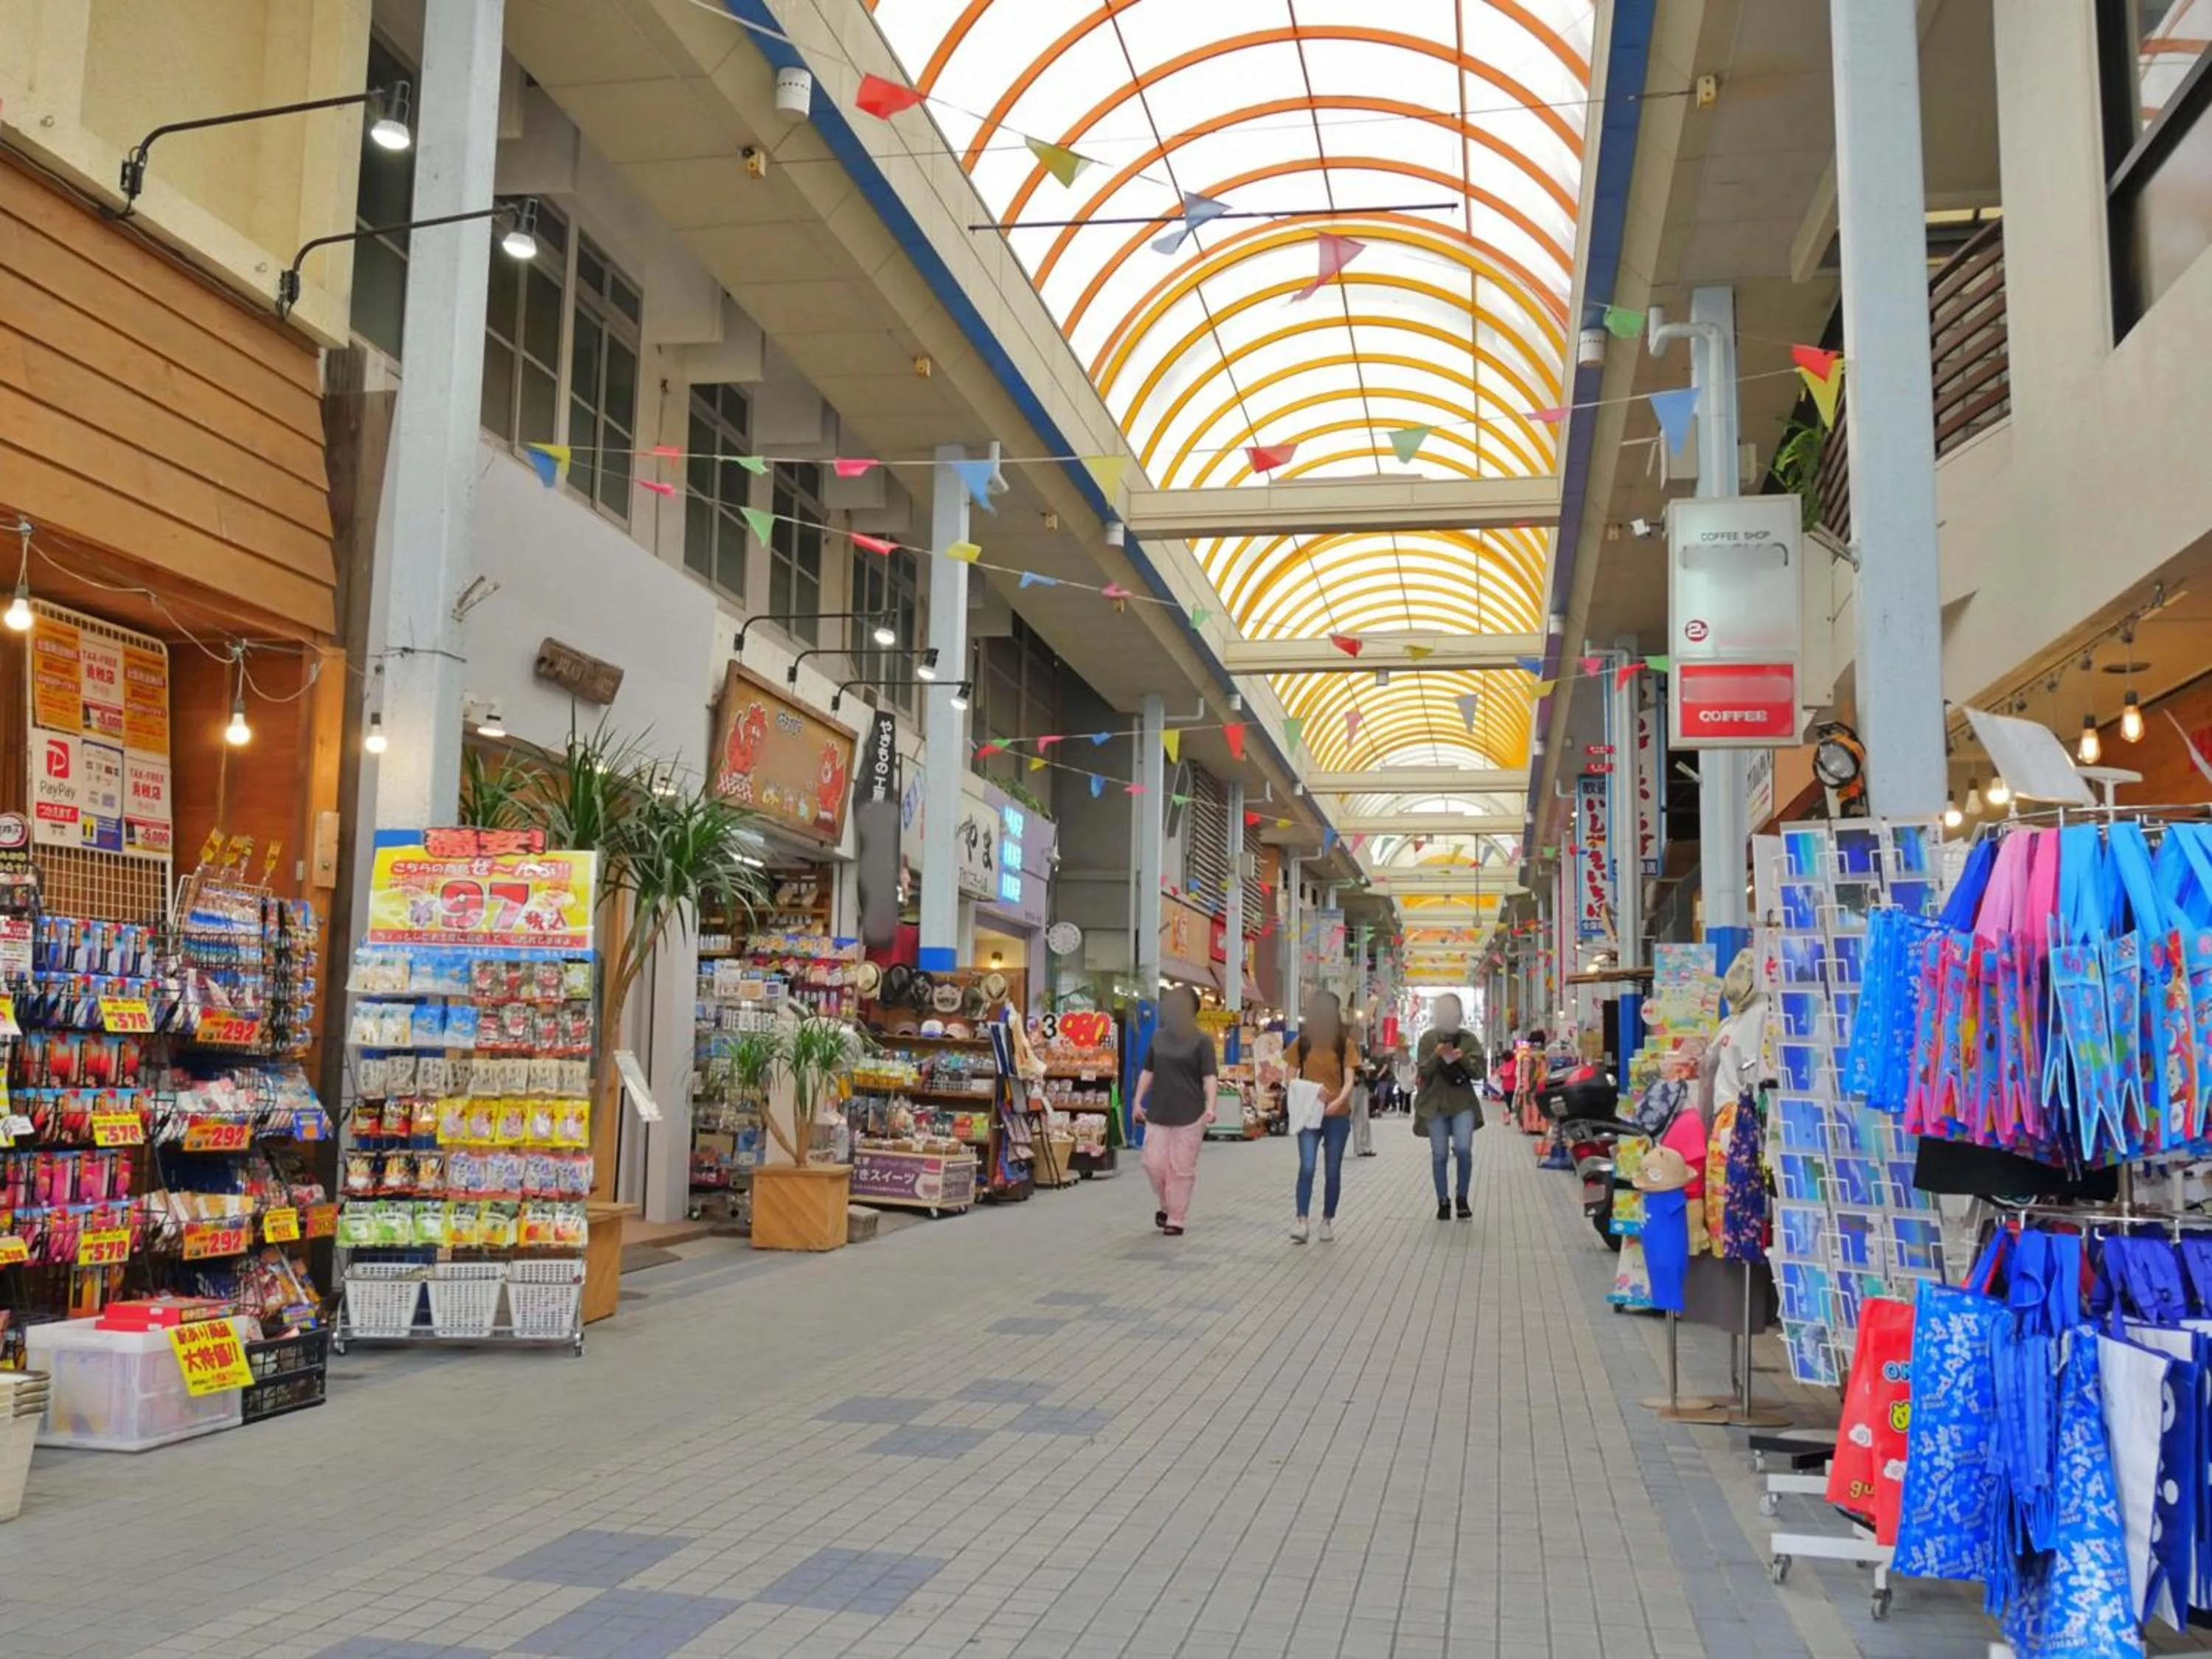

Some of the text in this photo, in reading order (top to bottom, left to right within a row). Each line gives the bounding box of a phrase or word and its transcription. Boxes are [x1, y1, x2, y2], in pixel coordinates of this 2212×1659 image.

[1701, 530, 1770, 542] COFFEE SHOP
[1699, 709, 1768, 723] COFFEE
[39, 779, 76, 801] PayPay
